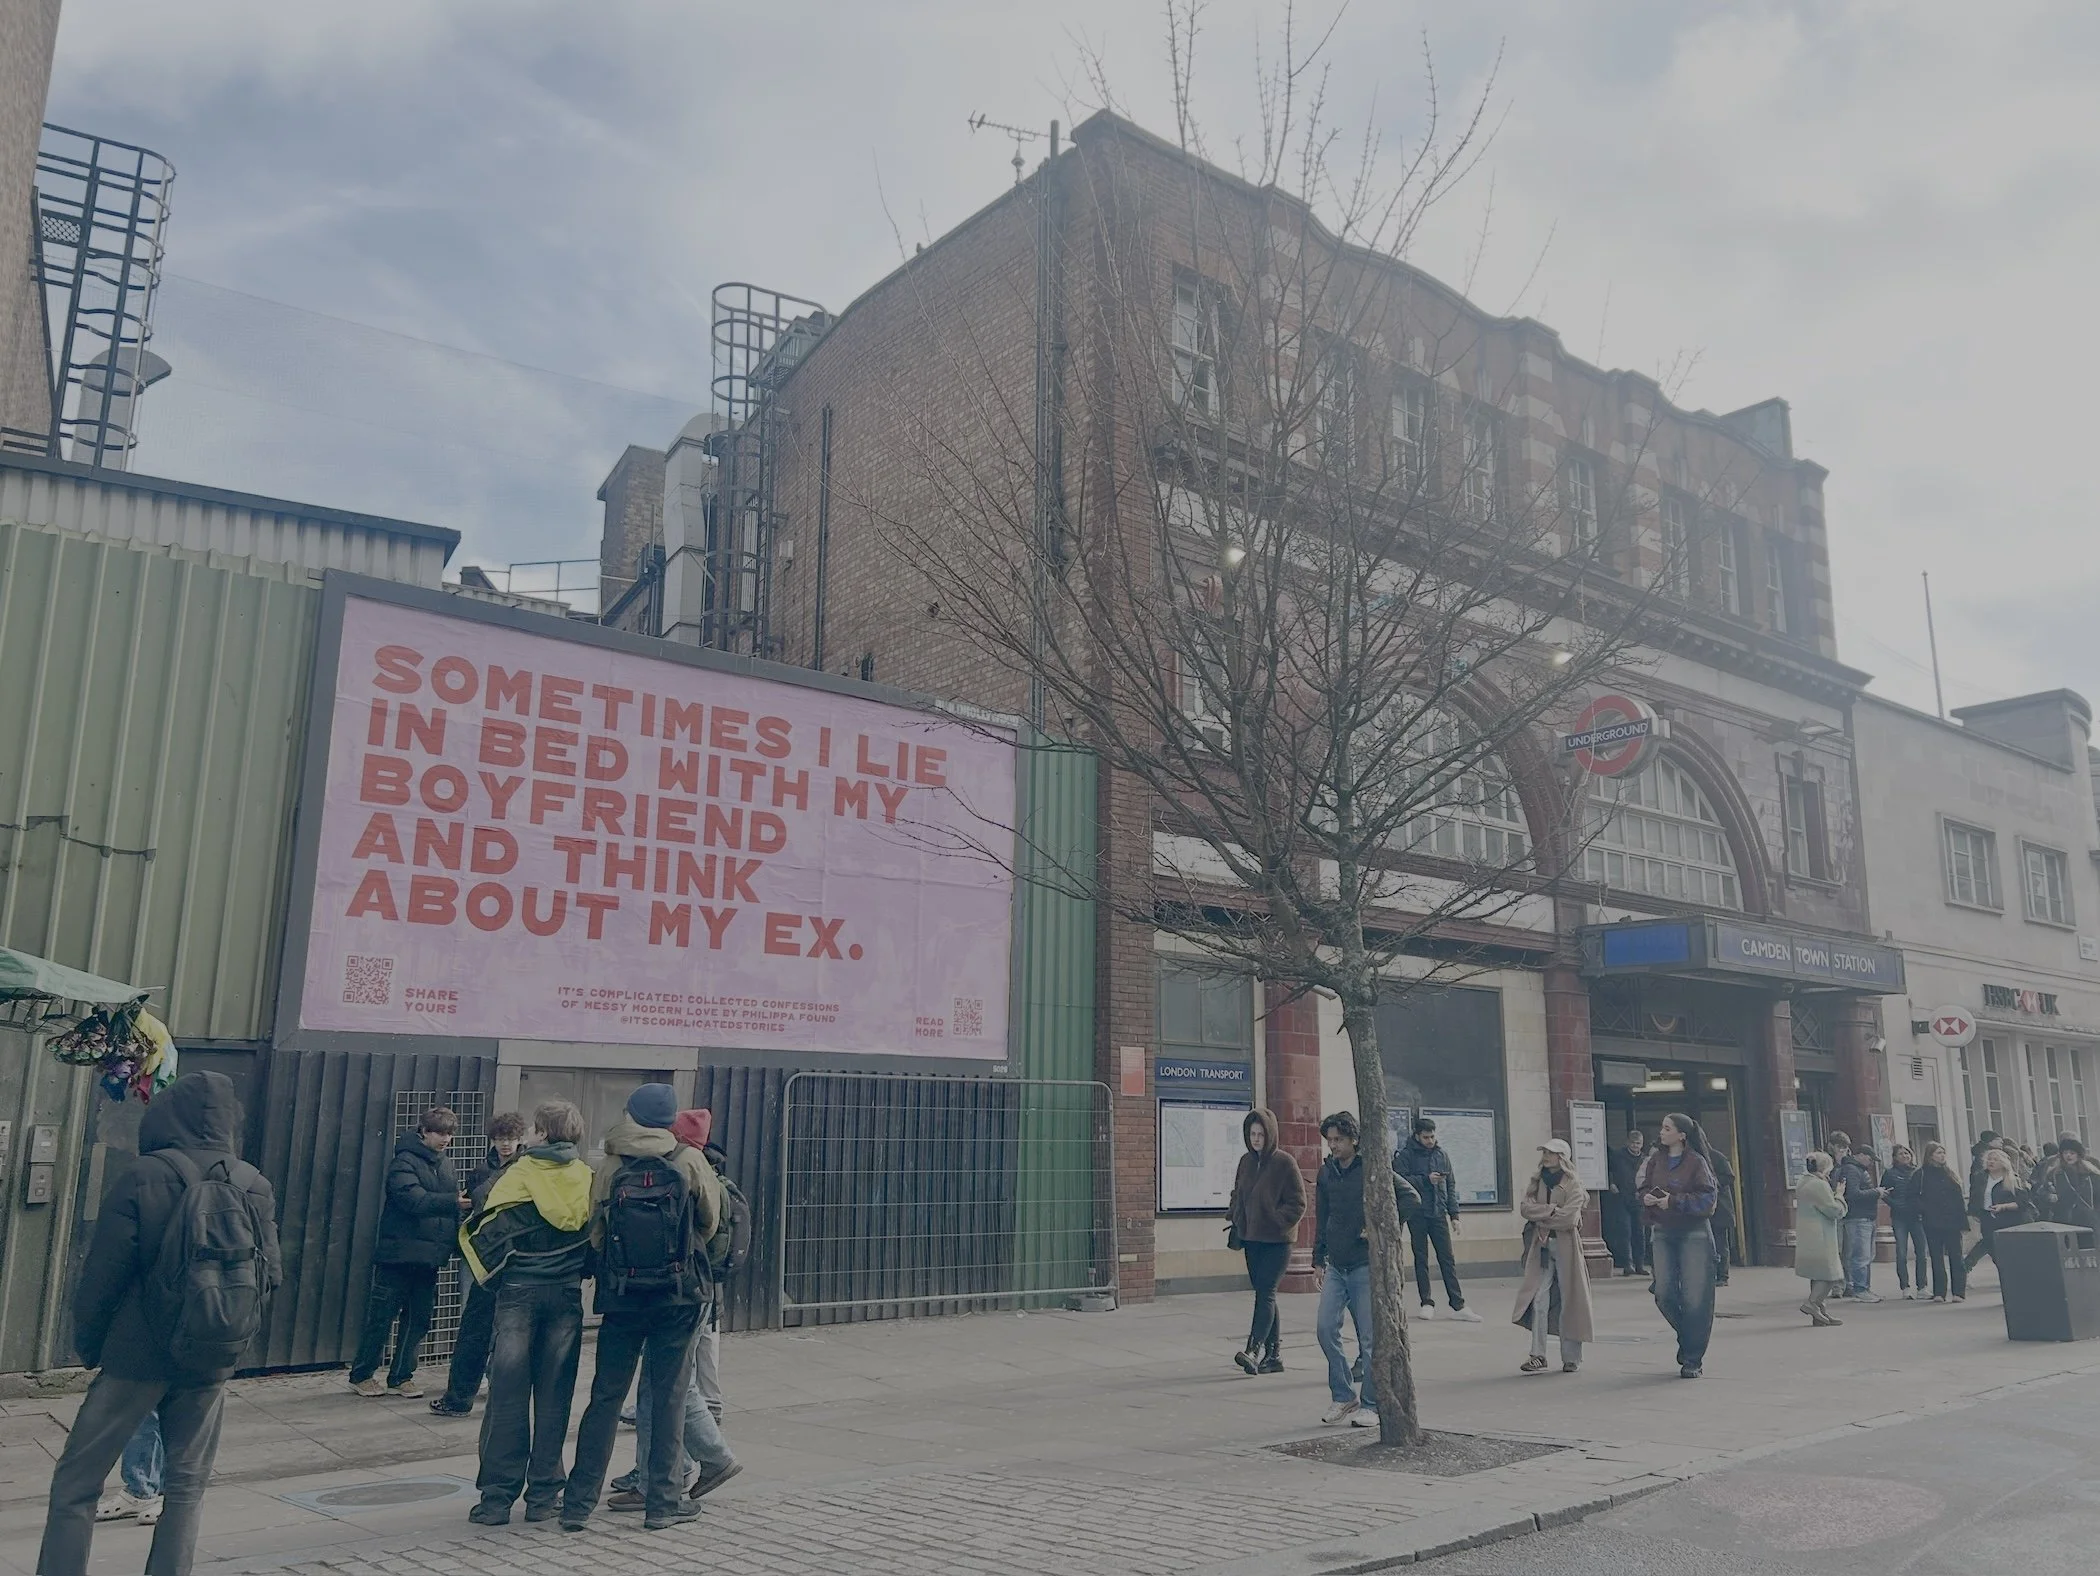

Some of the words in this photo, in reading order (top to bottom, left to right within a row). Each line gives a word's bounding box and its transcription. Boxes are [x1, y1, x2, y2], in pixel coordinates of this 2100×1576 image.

[372, 645, 793, 761] SOMETIMES
[817, 726, 832, 768] I
[855, 734, 948, 786] LIE
[1567, 722, 1648, 747] UNDERGROUND
[366, 698, 447, 756] IN
[477, 718, 630, 783] BED
[658, 746, 809, 811] WITH
[833, 776, 910, 825] MY
[359, 752, 788, 855] BOYFRIEND
[352, 812, 520, 876] AND
[552, 835, 764, 904] THINK
[344, 869, 621, 941] ABOUT
[649, 902, 738, 950] MY
[763, 912, 866, 962] EX.
[1741, 937, 1791, 961] CAMDEN
[1795, 946, 1829, 967] TOWN
[1833, 952, 1876, 975] STATION
[404, 987, 459, 1001] SHARE
[558, 986, 584, 997] IT'S
[687, 995, 758, 1008] COLLECTED
[762, 999, 840, 1013] CONFESSIONS
[404, 1001, 457, 1014] YOURS
[561, 999, 578, 1009] OF
[584, 1000, 627, 1012] MESSY
[632, 1003, 682, 1016] MODERN
[686, 1007, 719, 1017] LOVE
[722, 1008, 738, 1018] BY
[742, 1010, 795, 1021] PHILIPPA
[799, 1013, 836, 1024] FOUND
[620, 1015, 785, 1032] @ITSCOMPLICATEDSTORIES
[915, 1016, 944, 1026] READ
[915, 1027, 944, 1038] MORE
[1160, 1066, 1197, 1079] LONDON
[1199, 1068, 1244, 1080] TRANSPORT
